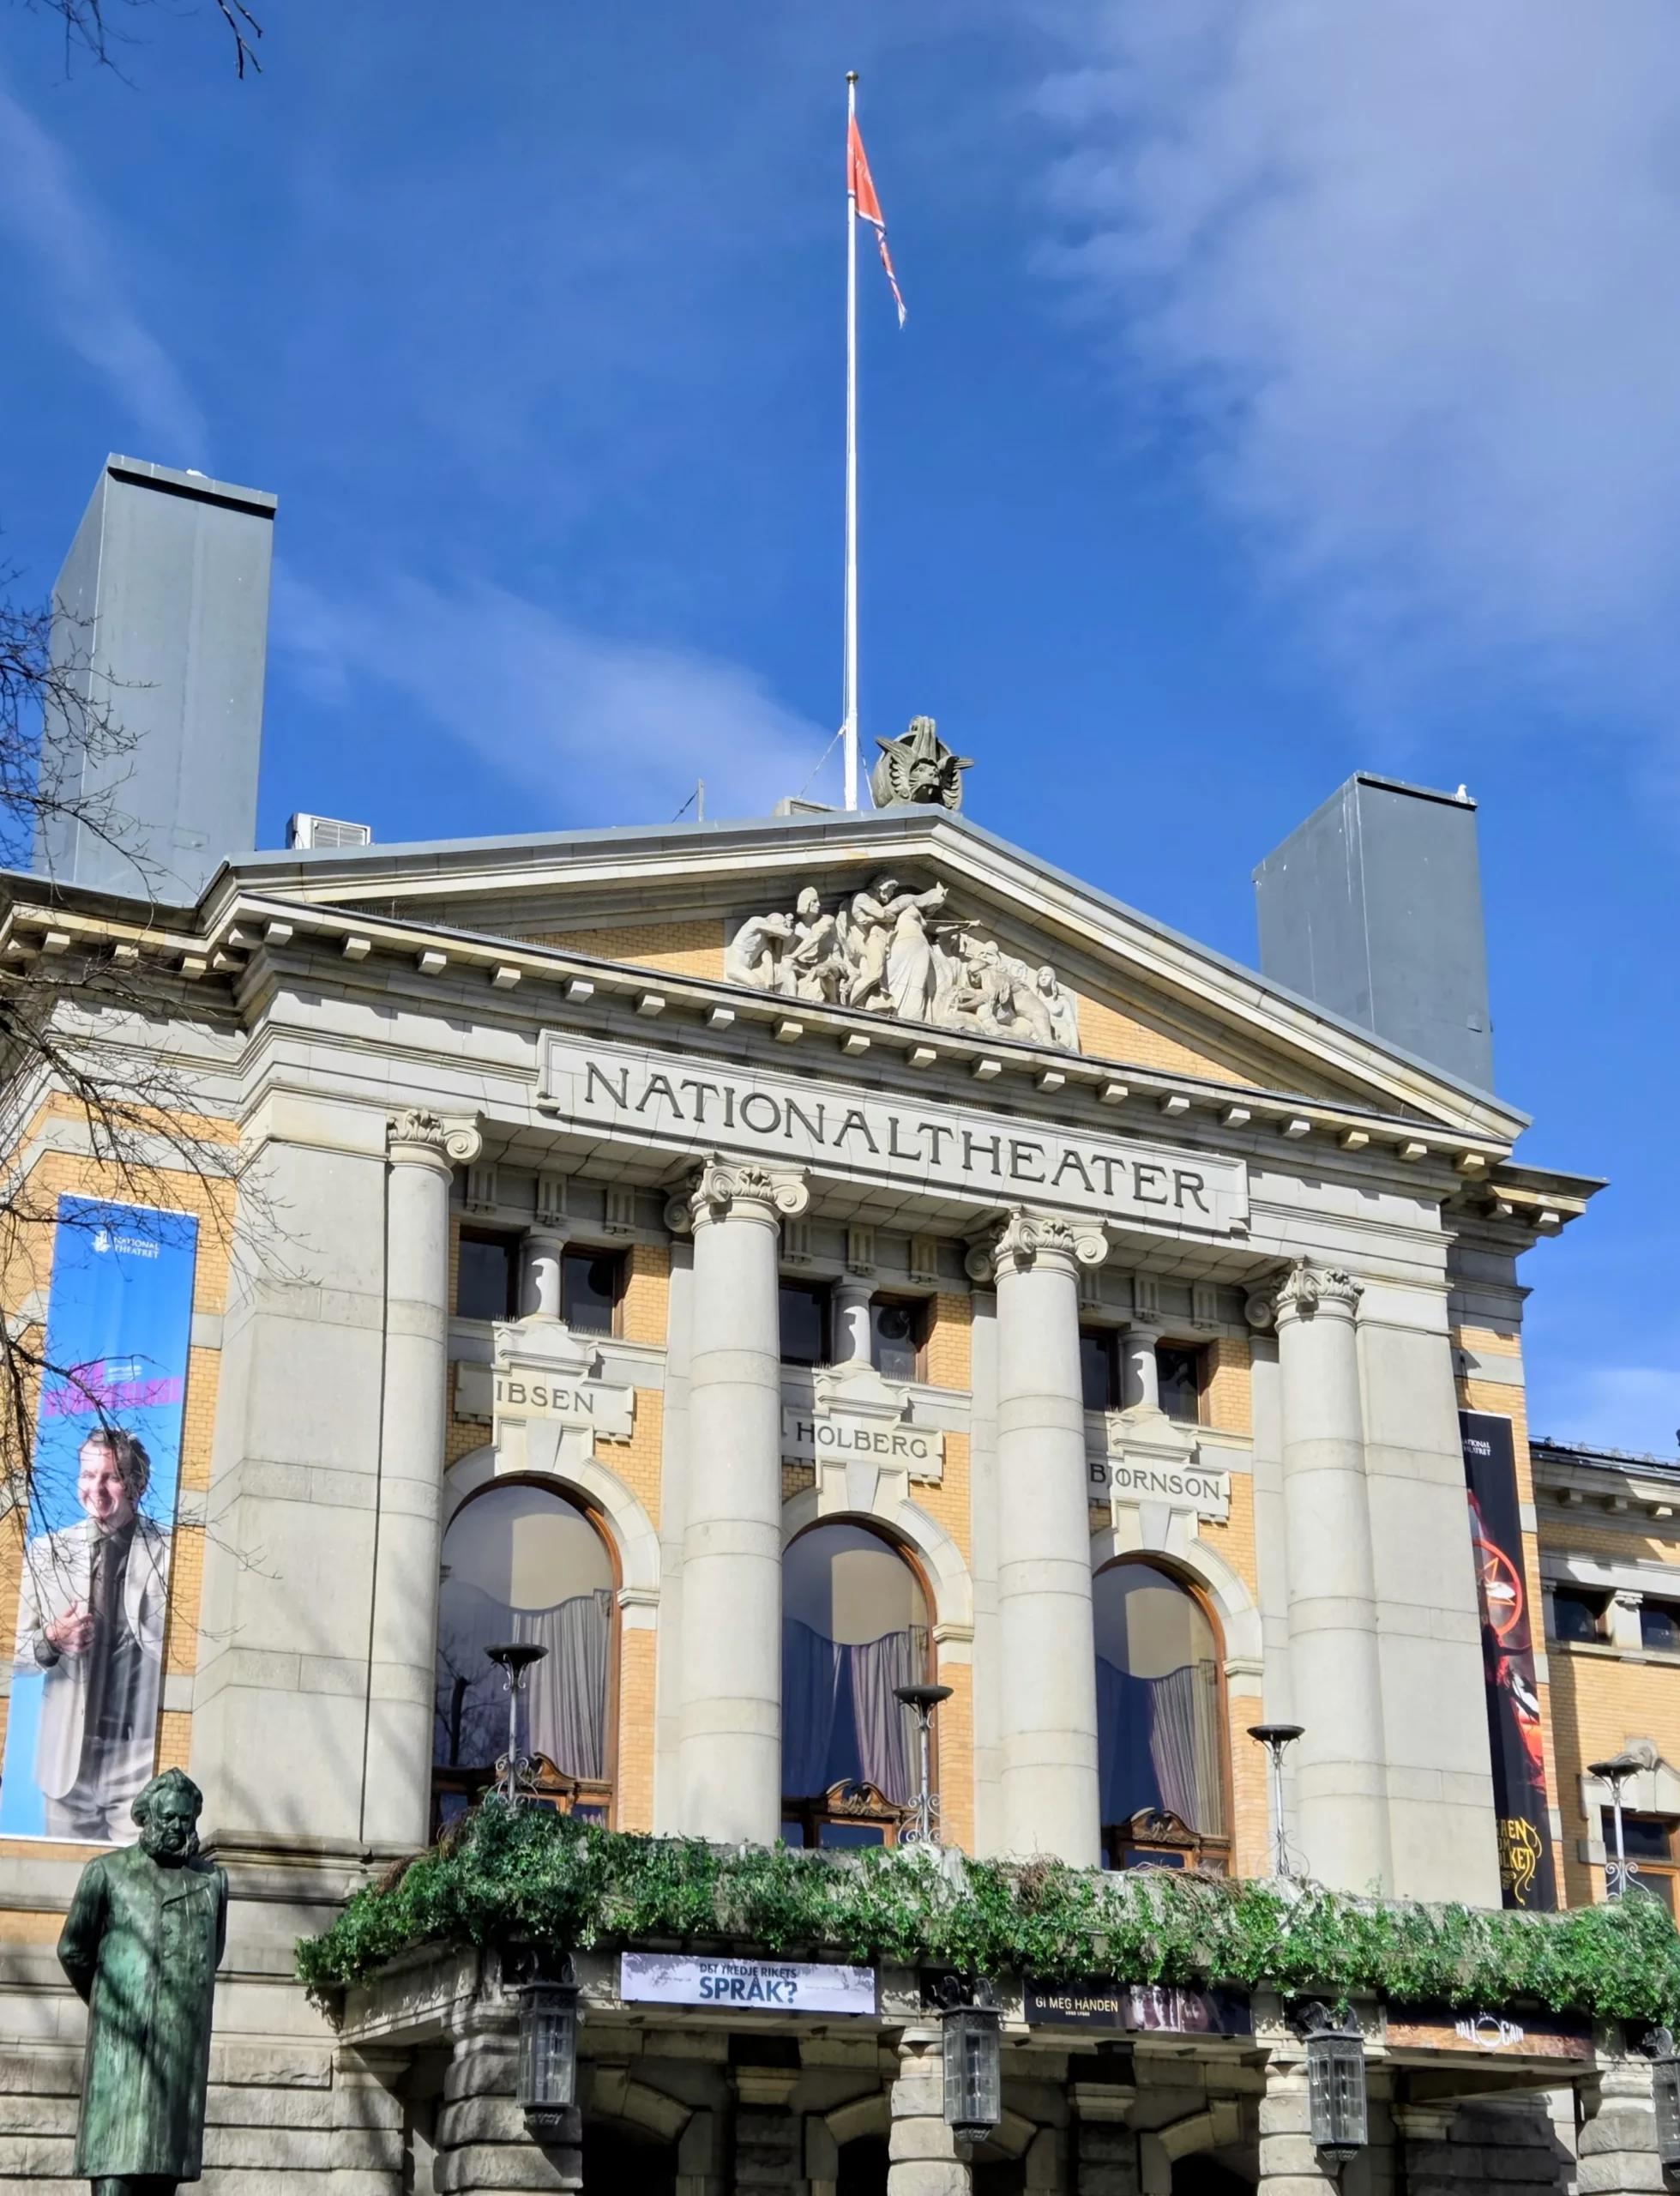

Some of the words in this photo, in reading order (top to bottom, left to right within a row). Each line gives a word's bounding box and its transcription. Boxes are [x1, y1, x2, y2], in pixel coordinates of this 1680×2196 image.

[585, 1061, 1210, 1213] NATIONALTHEATER
[113, 1235, 160, 1250] NATIONAL
[115, 1245, 160, 1259] THEATRET
[497, 1380, 594, 1415] IBSEN
[797, 1421, 927, 1458] HOLBERG
[1463, 1438, 1490, 1449] ATIONAL
[700, 1964, 718, 1974] DET
[761, 1967, 797, 1979] RIKETS
[700, 1975, 798, 2004] SPRÅK?
[1035, 1996, 1046, 2008] GI
[1049, 1996, 1072, 2009] MEG
[1075, 1997, 1118, 2012] HÅNDEN
